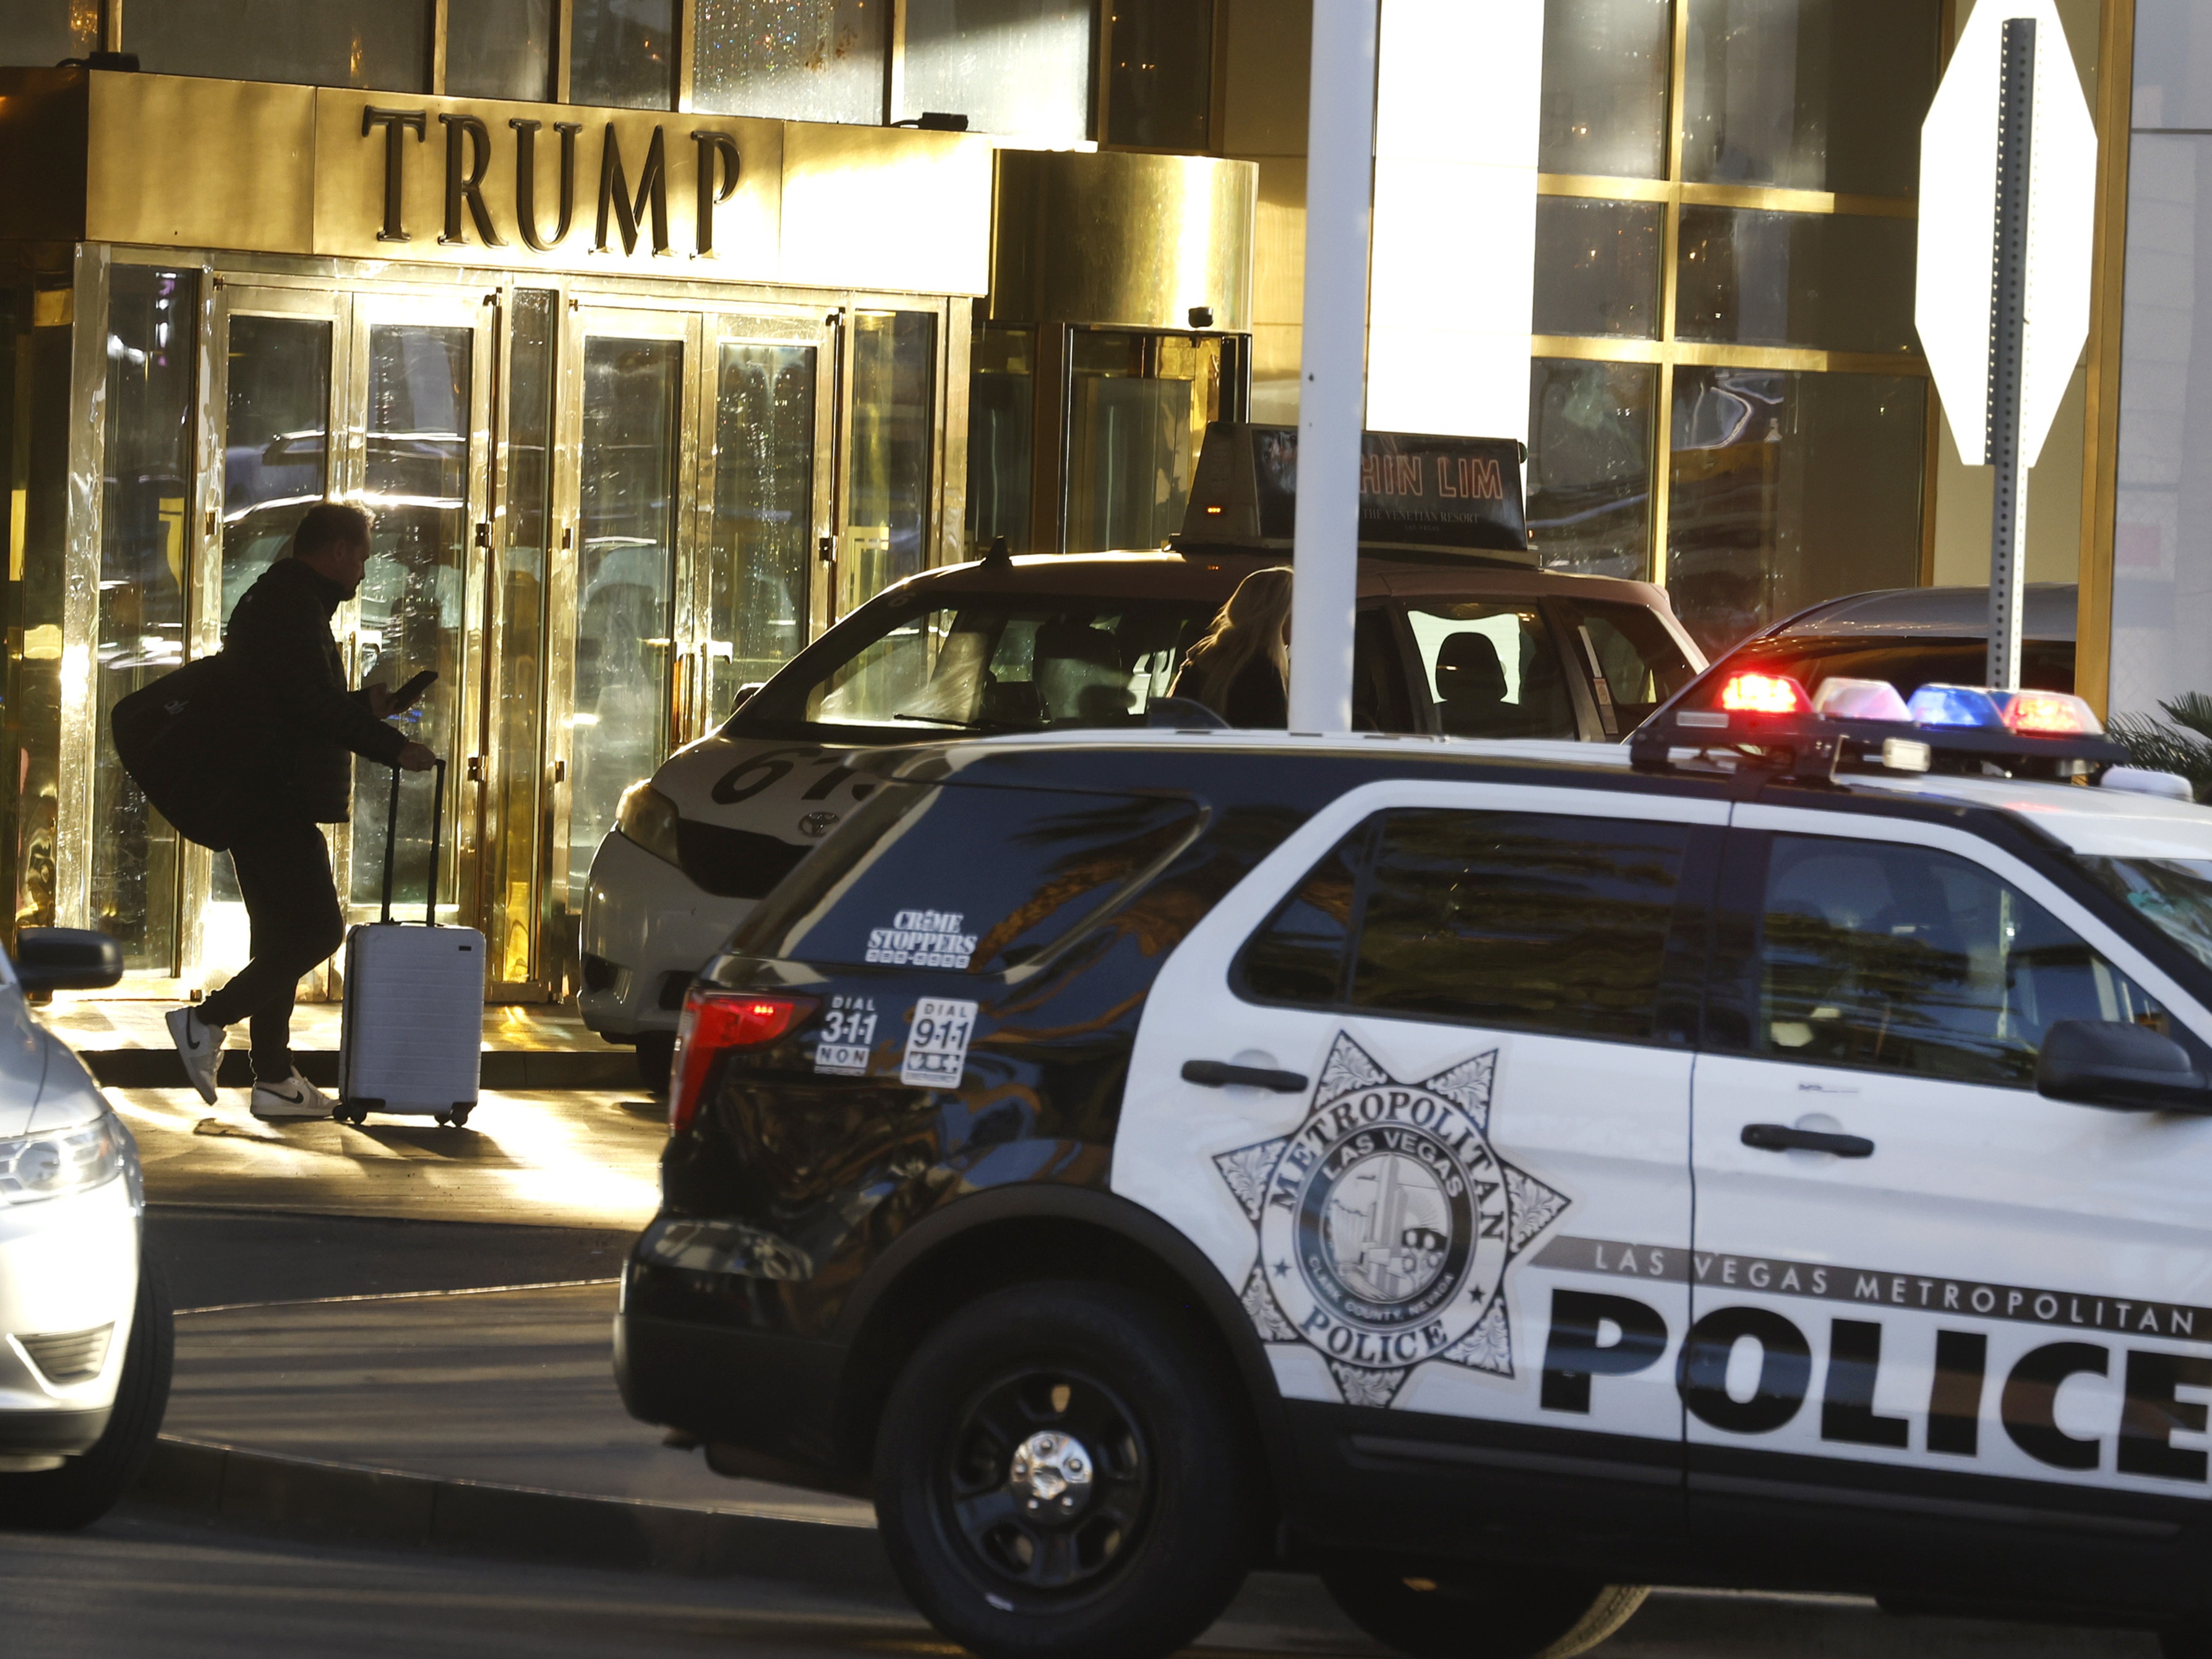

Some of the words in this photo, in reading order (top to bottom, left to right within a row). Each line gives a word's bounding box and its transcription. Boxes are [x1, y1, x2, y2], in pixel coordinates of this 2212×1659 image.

[362, 105, 740, 260] TRUMP
[1360, 453, 1423, 497] HIN
[1437, 457, 1503, 499] LIM
[1362, 508, 1383, 520] THE
[1385, 509, 1438, 522] VENETIAN
[1439, 511, 1480, 524] RESORT
[711, 747, 876, 805] 67
[867, 928, 979, 955] STOPPERS
[832, 997, 875, 1011] DIAL
[924, 1003, 967, 1018] DIAL
[821, 1047, 865, 1063] NON
[1269, 1091, 1504, 1241] METROPOLITAN
[1322, 1133, 1375, 1181] LAS
[1382, 1130, 1464, 1198] VEGAS
[1595, 1245, 1665, 1276] LAS
[1693, 1255, 1828, 1295] VEGAS
[1854, 1274, 2194, 1335] METROPOLITAN
[1301, 1305, 1447, 1361] POLICE
[1541, 1288, 2212, 1483] POLICE
